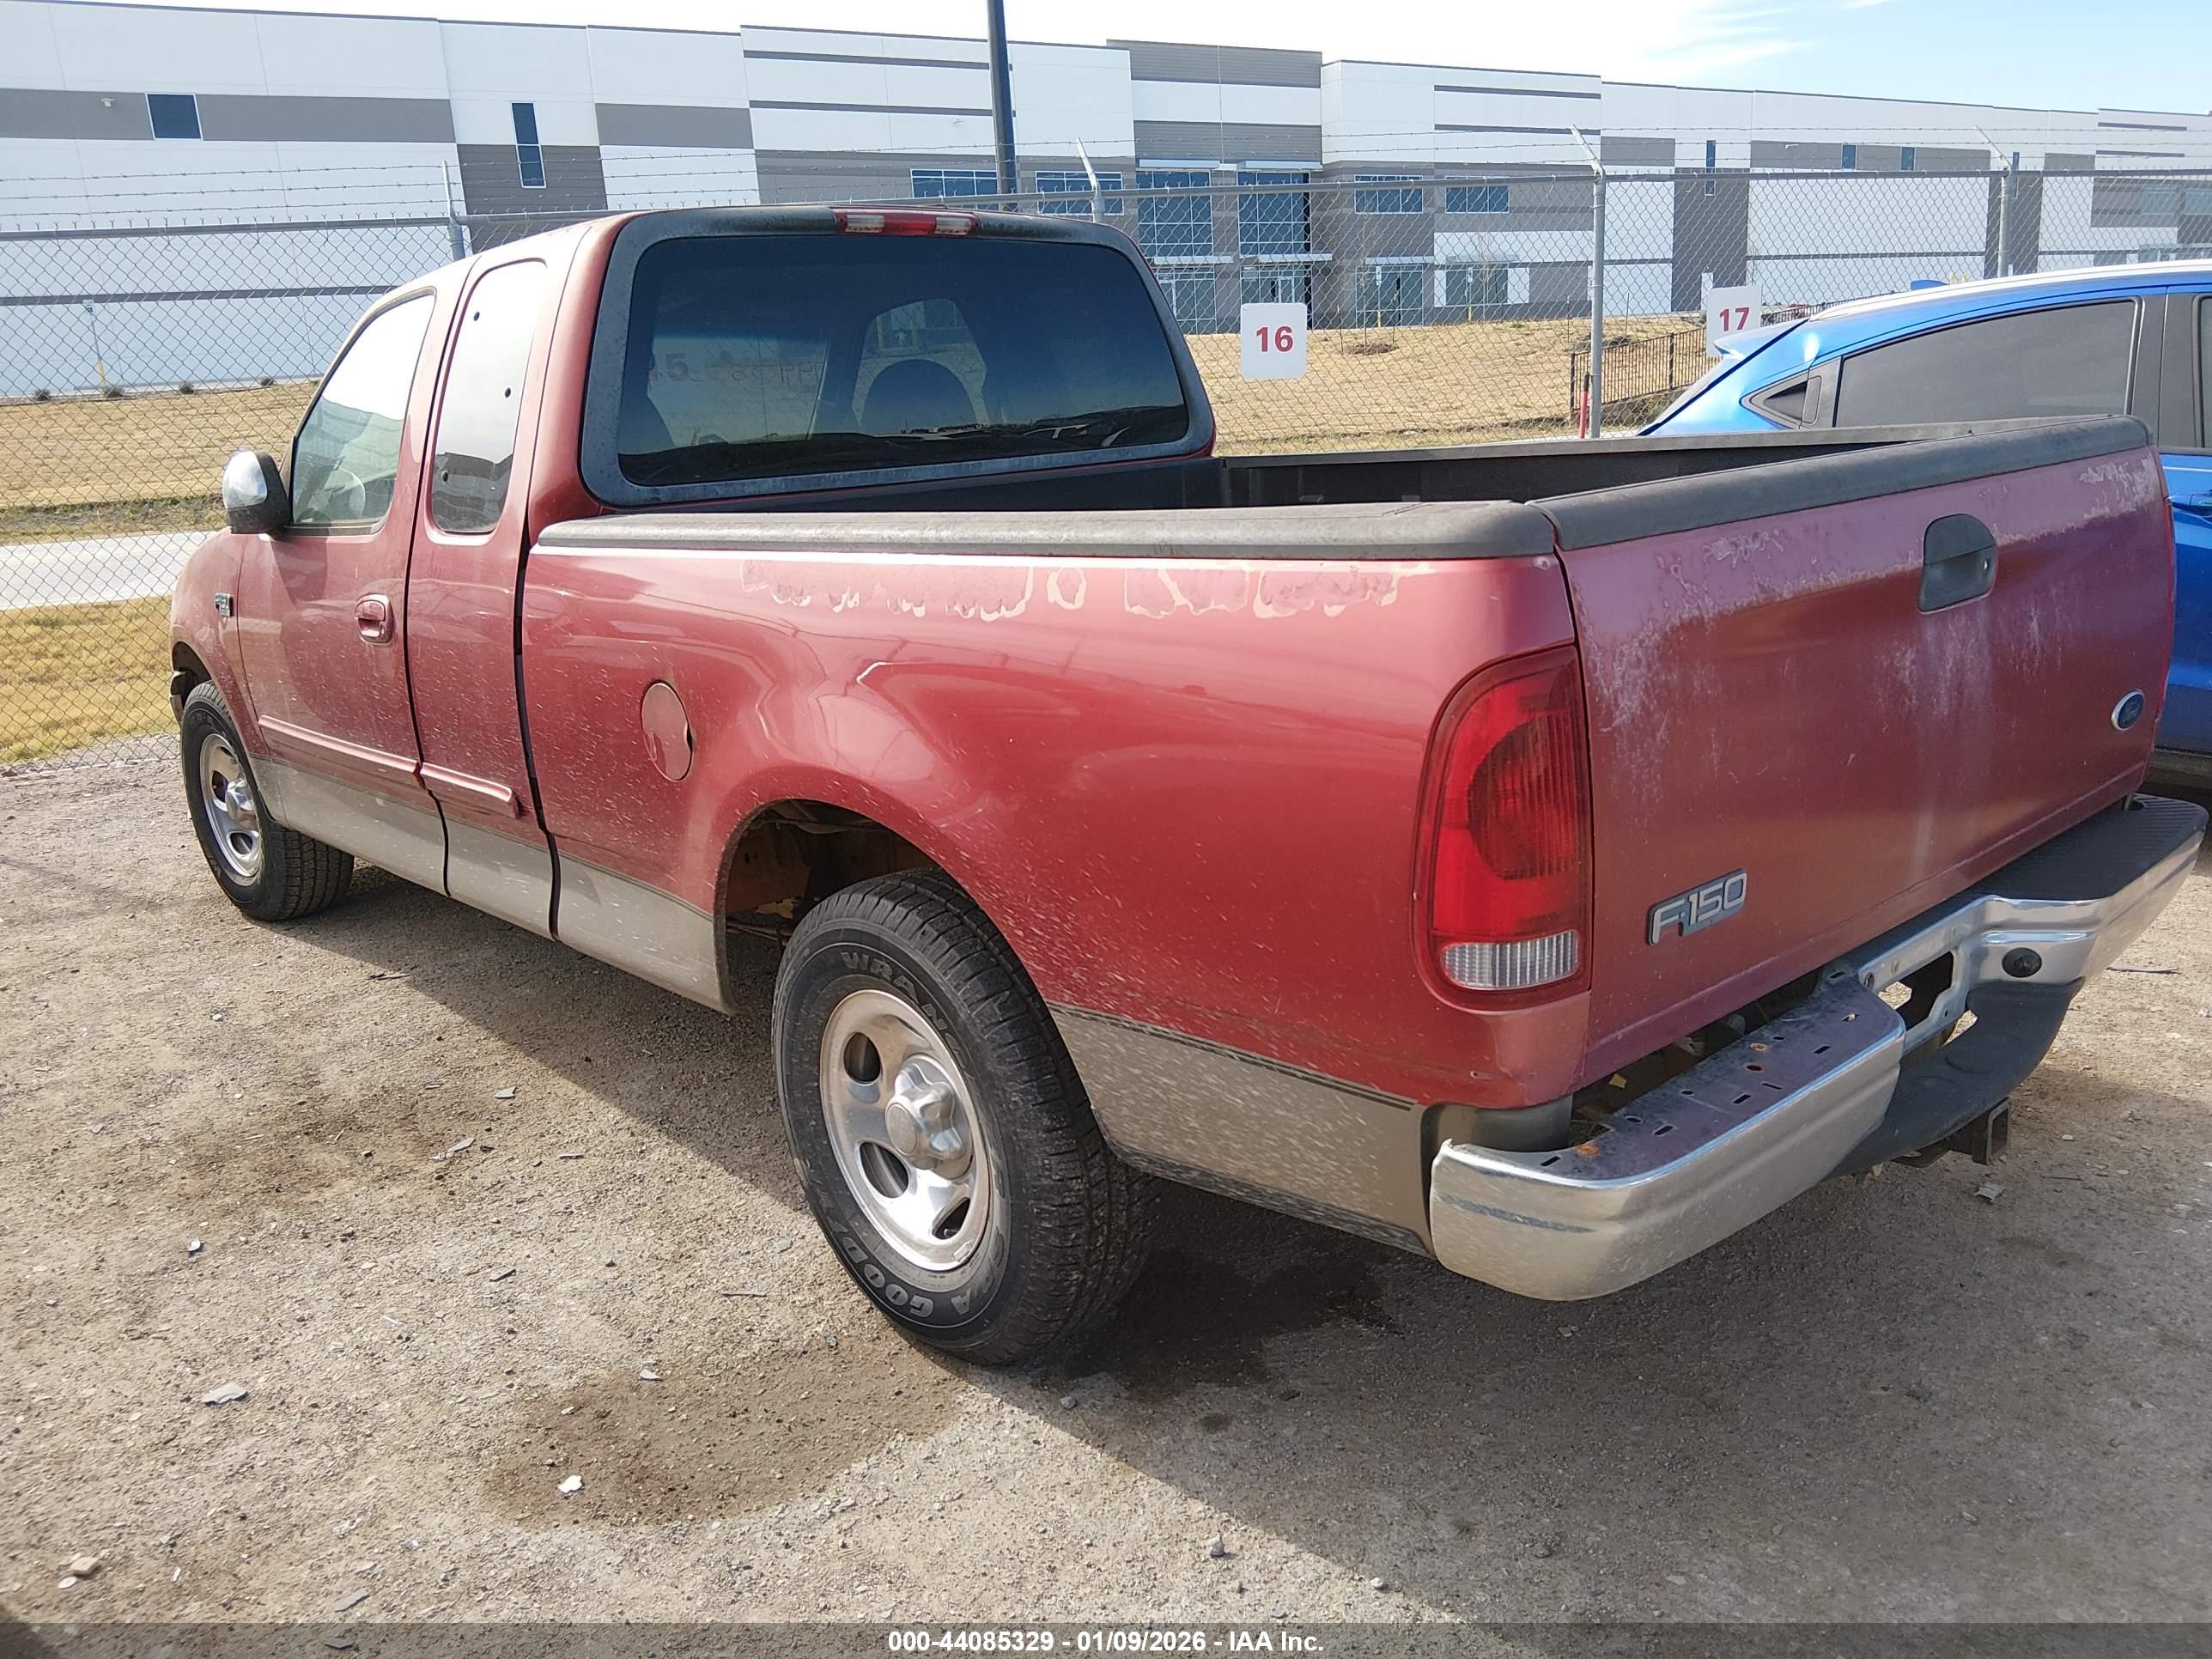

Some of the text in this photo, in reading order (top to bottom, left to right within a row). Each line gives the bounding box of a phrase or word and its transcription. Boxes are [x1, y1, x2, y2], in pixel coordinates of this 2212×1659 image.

[1719, 307, 1750, 332] 17
[1256, 325, 1293, 352] 16
[656, 353, 689, 381] 5
